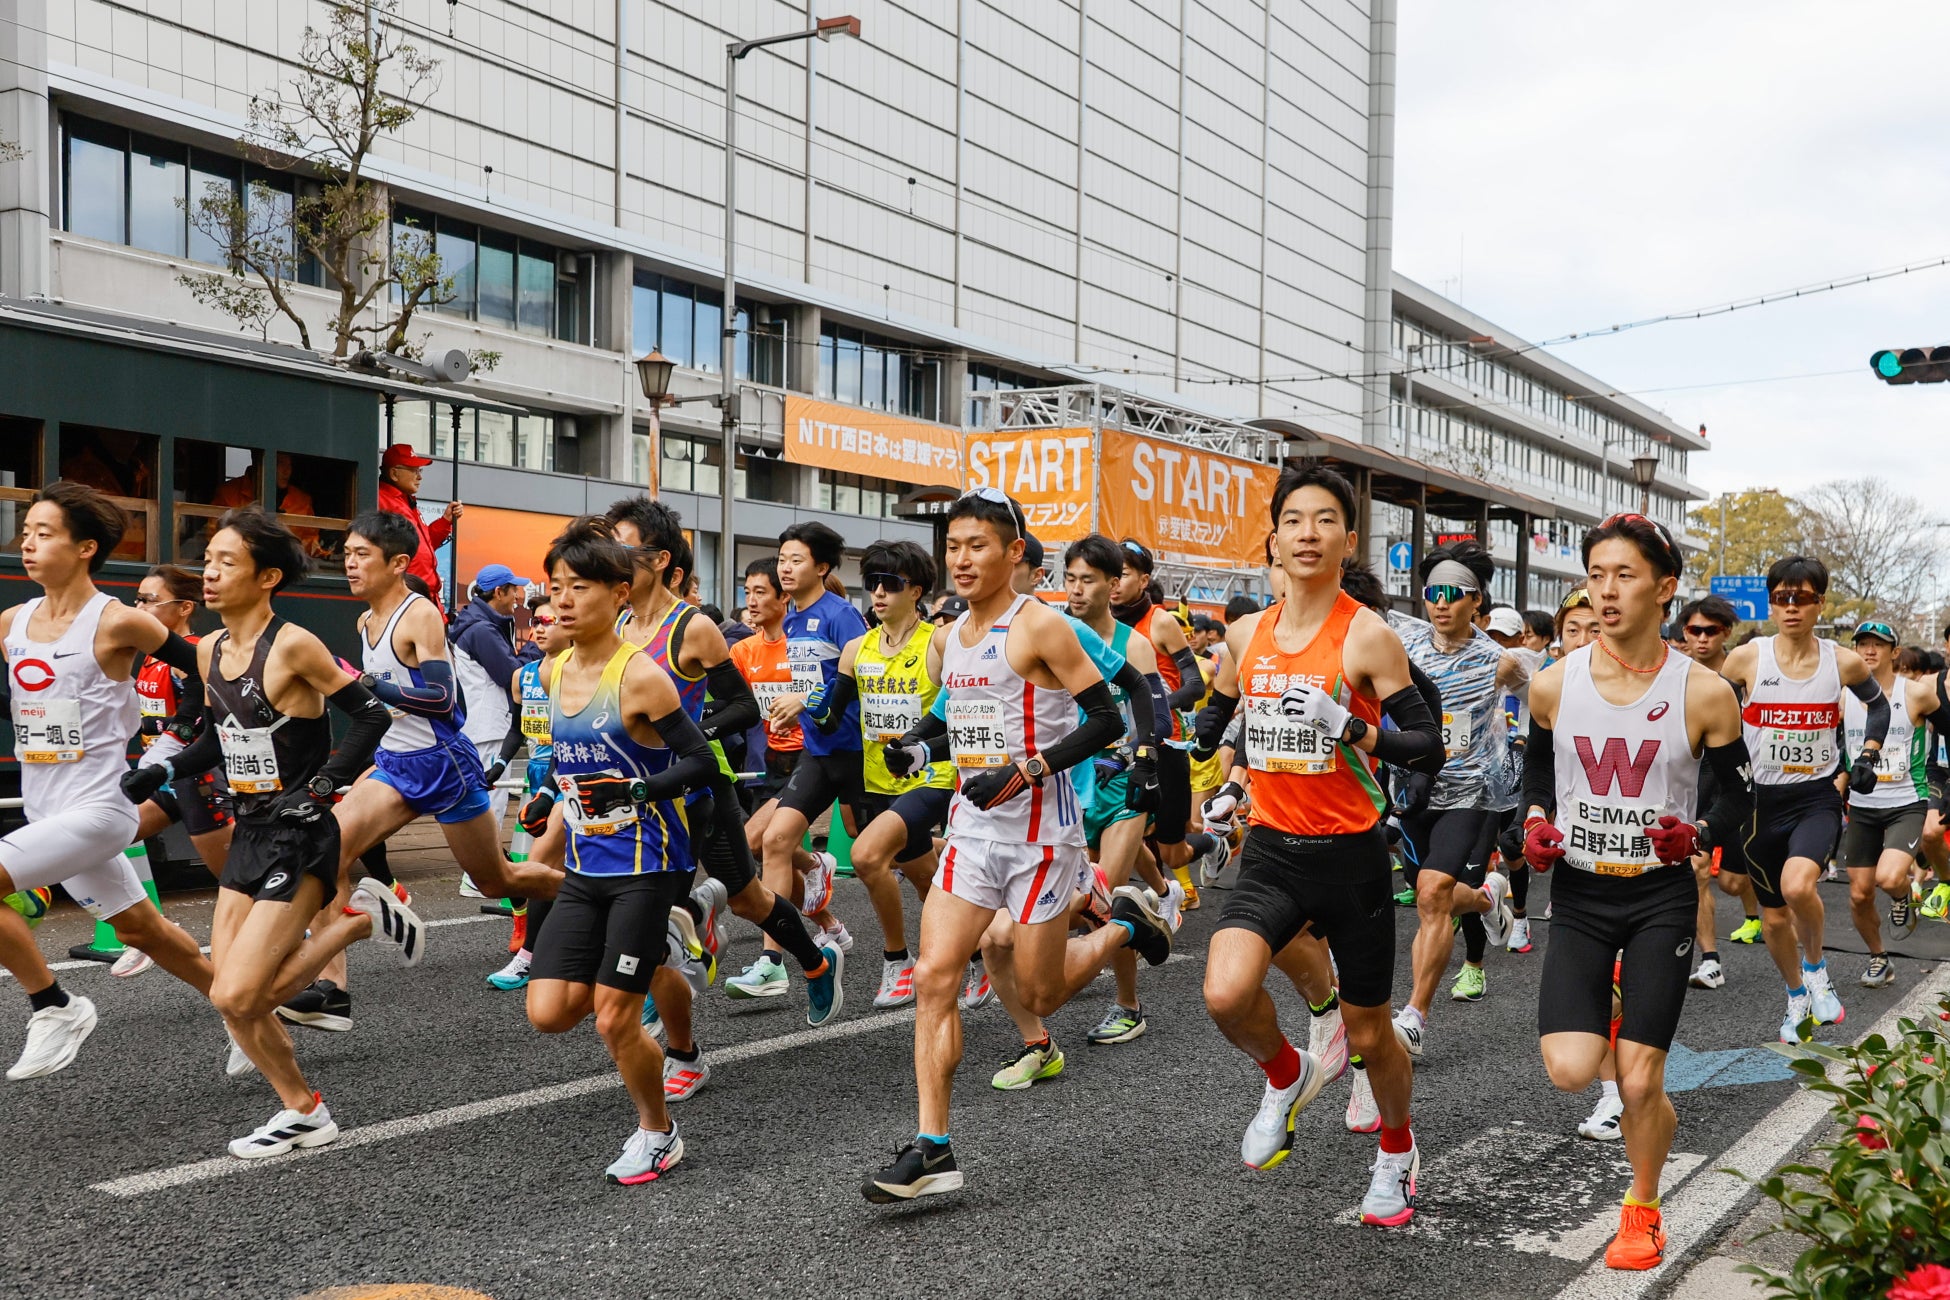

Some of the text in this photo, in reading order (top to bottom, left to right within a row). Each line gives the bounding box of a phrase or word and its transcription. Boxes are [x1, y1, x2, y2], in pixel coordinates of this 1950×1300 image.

[968, 436, 1090, 493] START
[1131, 442, 1254, 518] START
[1169, 516, 1228, 547] 愛媛マラソン
[945, 672, 995, 688] Aisan
[20, 707, 46, 718] meiji
[1760, 709, 1802, 725] 川之江
[68, 729, 81, 746] S
[948, 726, 1005, 749] 木洋平 S
[1248, 725, 1334, 755] 中村佳樹 S
[1460, 734, 1469, 747] S
[1787, 731, 1820, 743] FUJI
[1769, 744, 1830, 763] 1033 S
[263, 758, 276, 775] S
[1573, 736, 1662, 797] W
[1570, 825, 1652, 859] 日野斗馬
